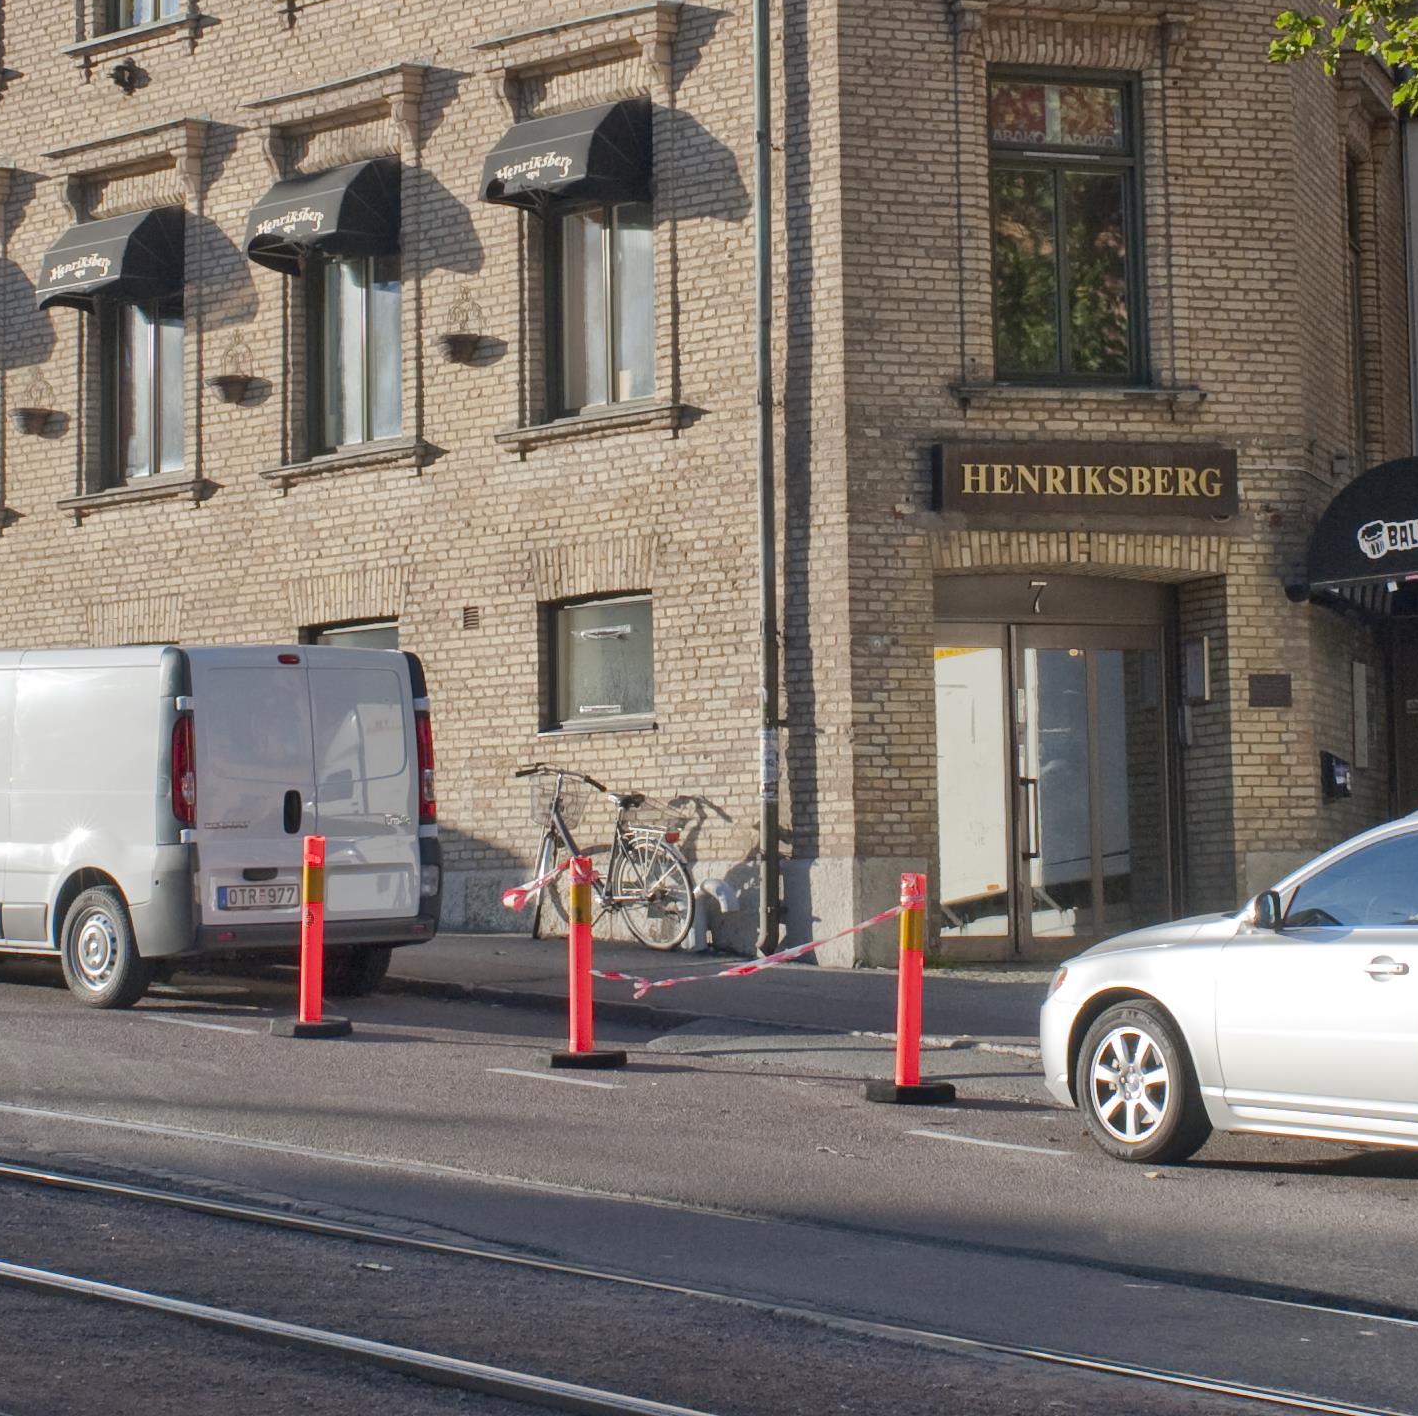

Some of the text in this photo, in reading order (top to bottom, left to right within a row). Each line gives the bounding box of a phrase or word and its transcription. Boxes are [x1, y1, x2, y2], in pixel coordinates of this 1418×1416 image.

[960, 463, 1223, 497] HENRIKSBERG
[229, 886, 295, 905] OTR 977
